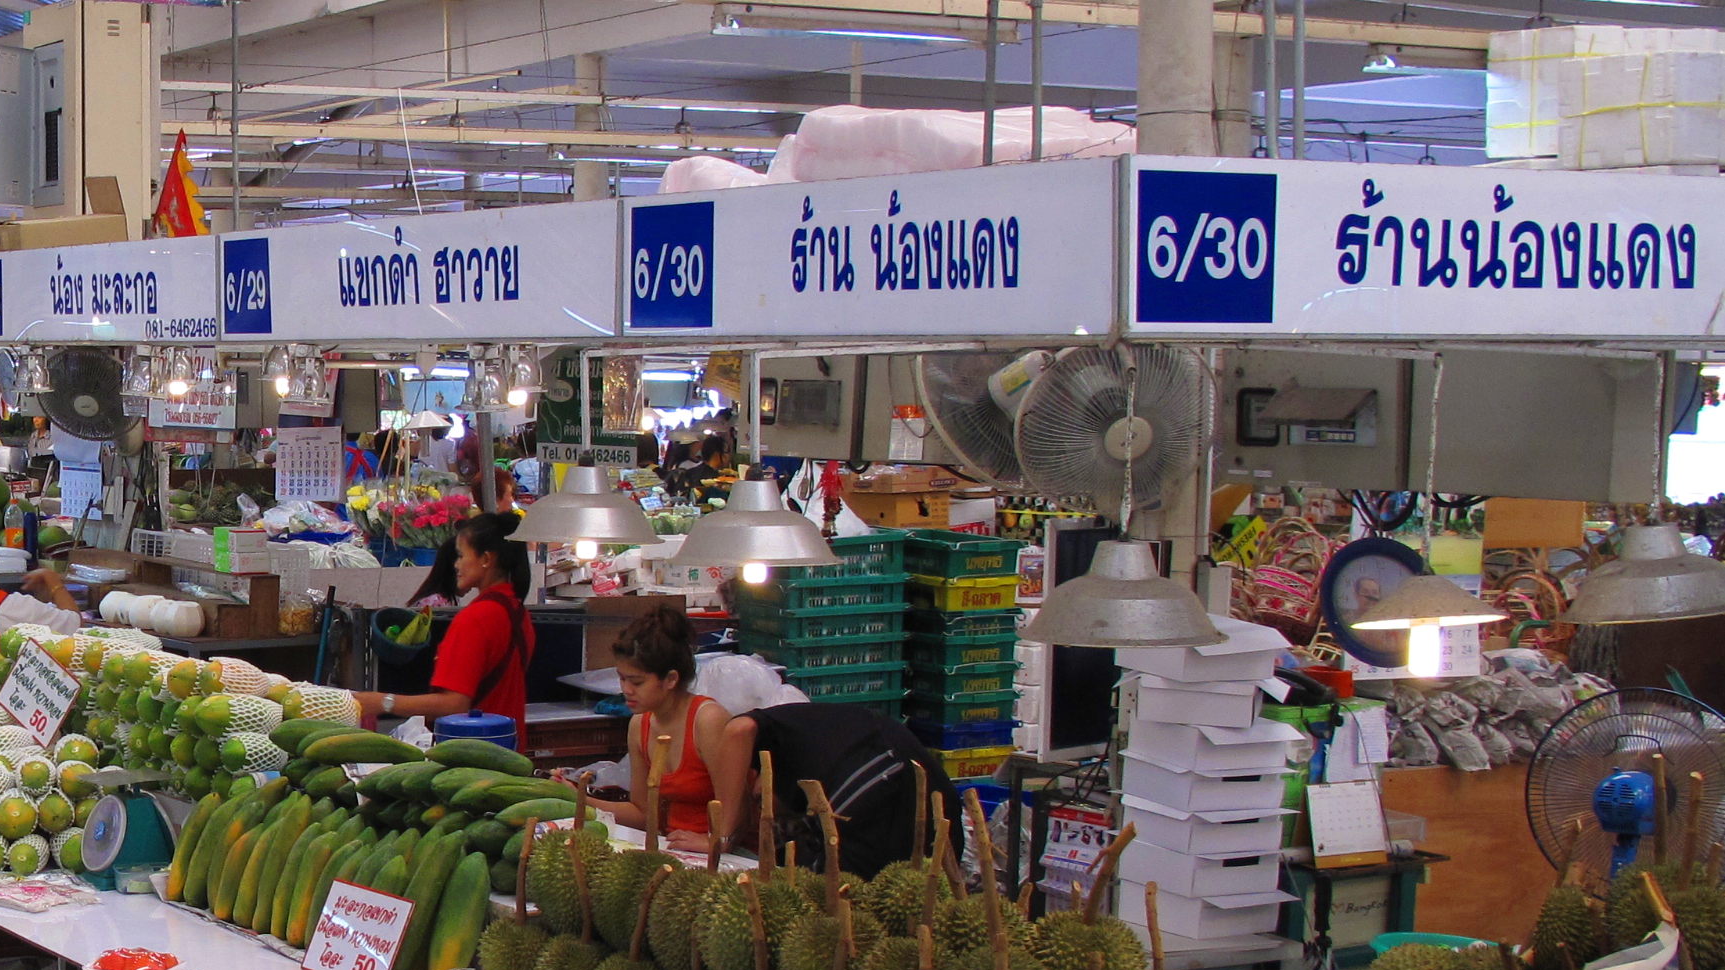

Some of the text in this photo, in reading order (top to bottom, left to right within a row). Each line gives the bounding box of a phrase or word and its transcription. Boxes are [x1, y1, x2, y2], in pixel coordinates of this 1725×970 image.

[789, 188, 1020, 294] ร้าน น้องแดง
[1147, 212, 1267, 282] 6/30
[1335, 177, 1697, 289] ร้านน้องแดง
[50, 253, 158, 316] น้อง มะละกอ
[225, 269, 267, 313] 6/29
[433, 243, 520, 304] ฮาวาย
[632, 243, 705, 302] 6/30
[144, 318, 217, 340] 081-6462466
[541, 446, 561, 461] Tel.
